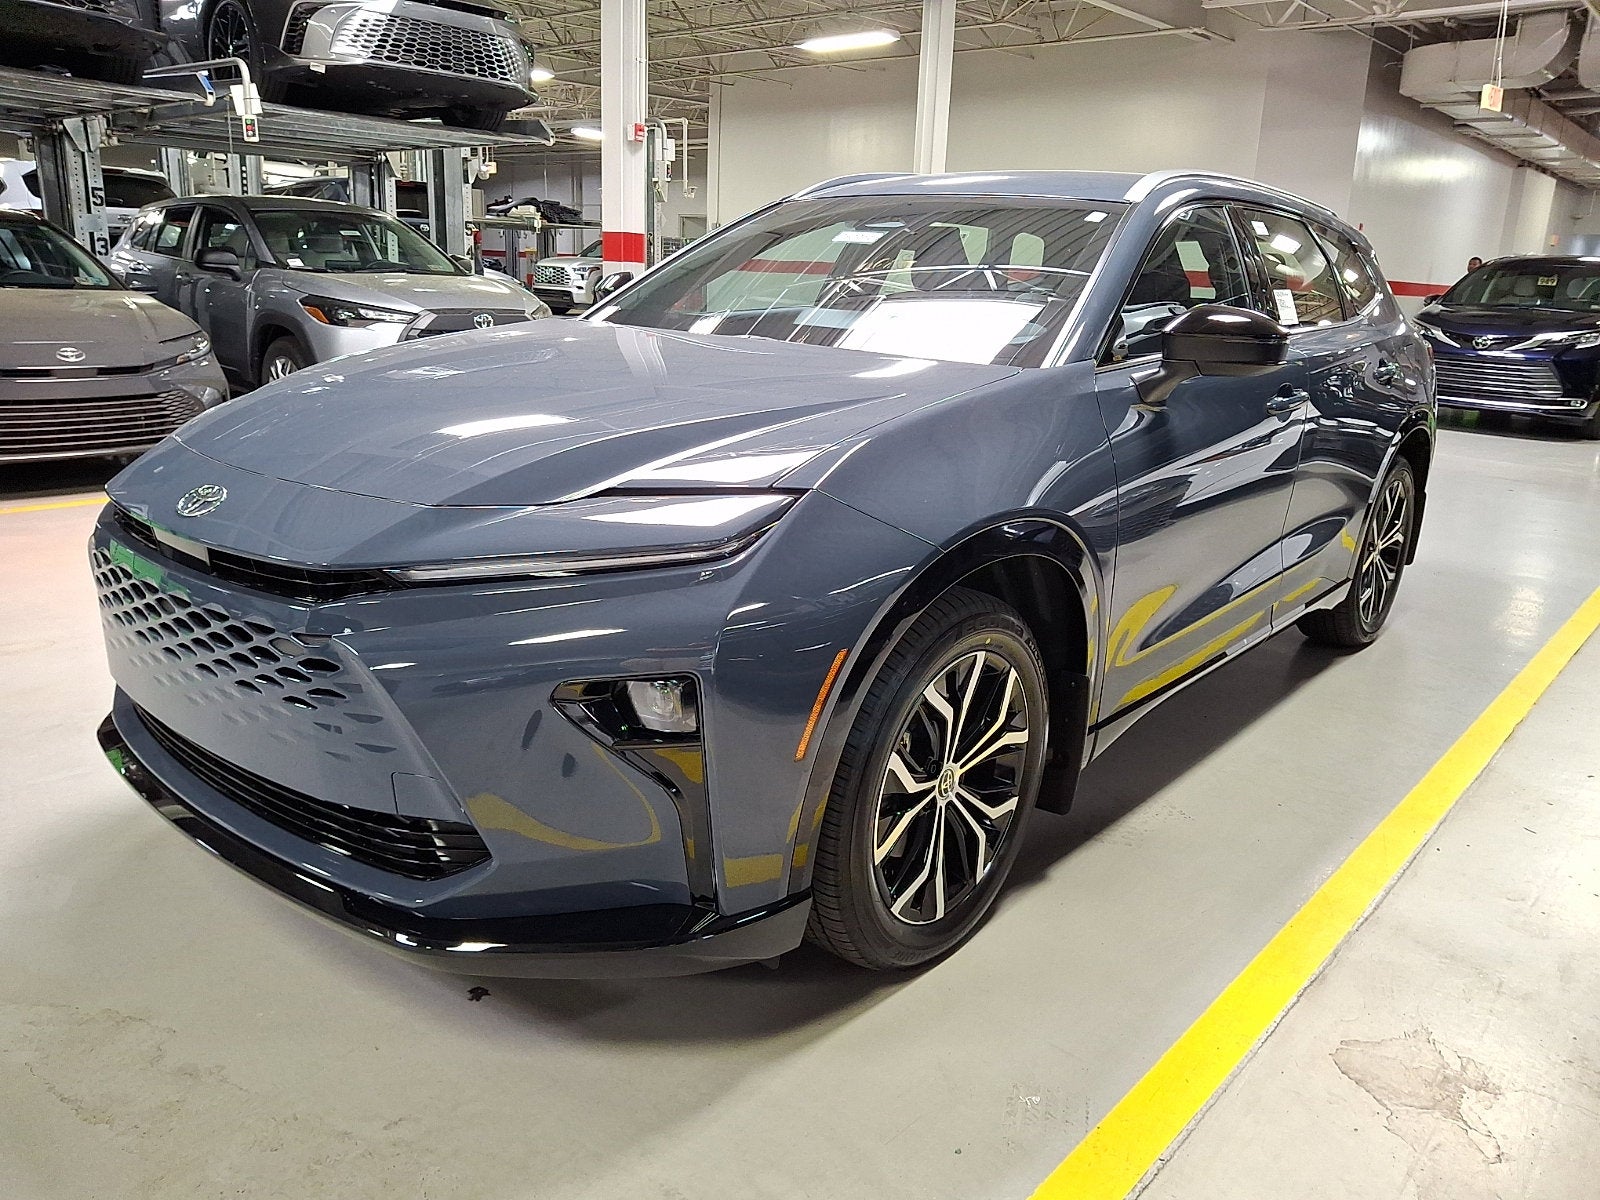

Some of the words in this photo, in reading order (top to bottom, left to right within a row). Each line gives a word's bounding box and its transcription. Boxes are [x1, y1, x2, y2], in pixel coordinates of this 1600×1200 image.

[91, 187, 104, 206] 5
[465, 221, 473, 236] 5
[96, 236, 109, 256] 3
